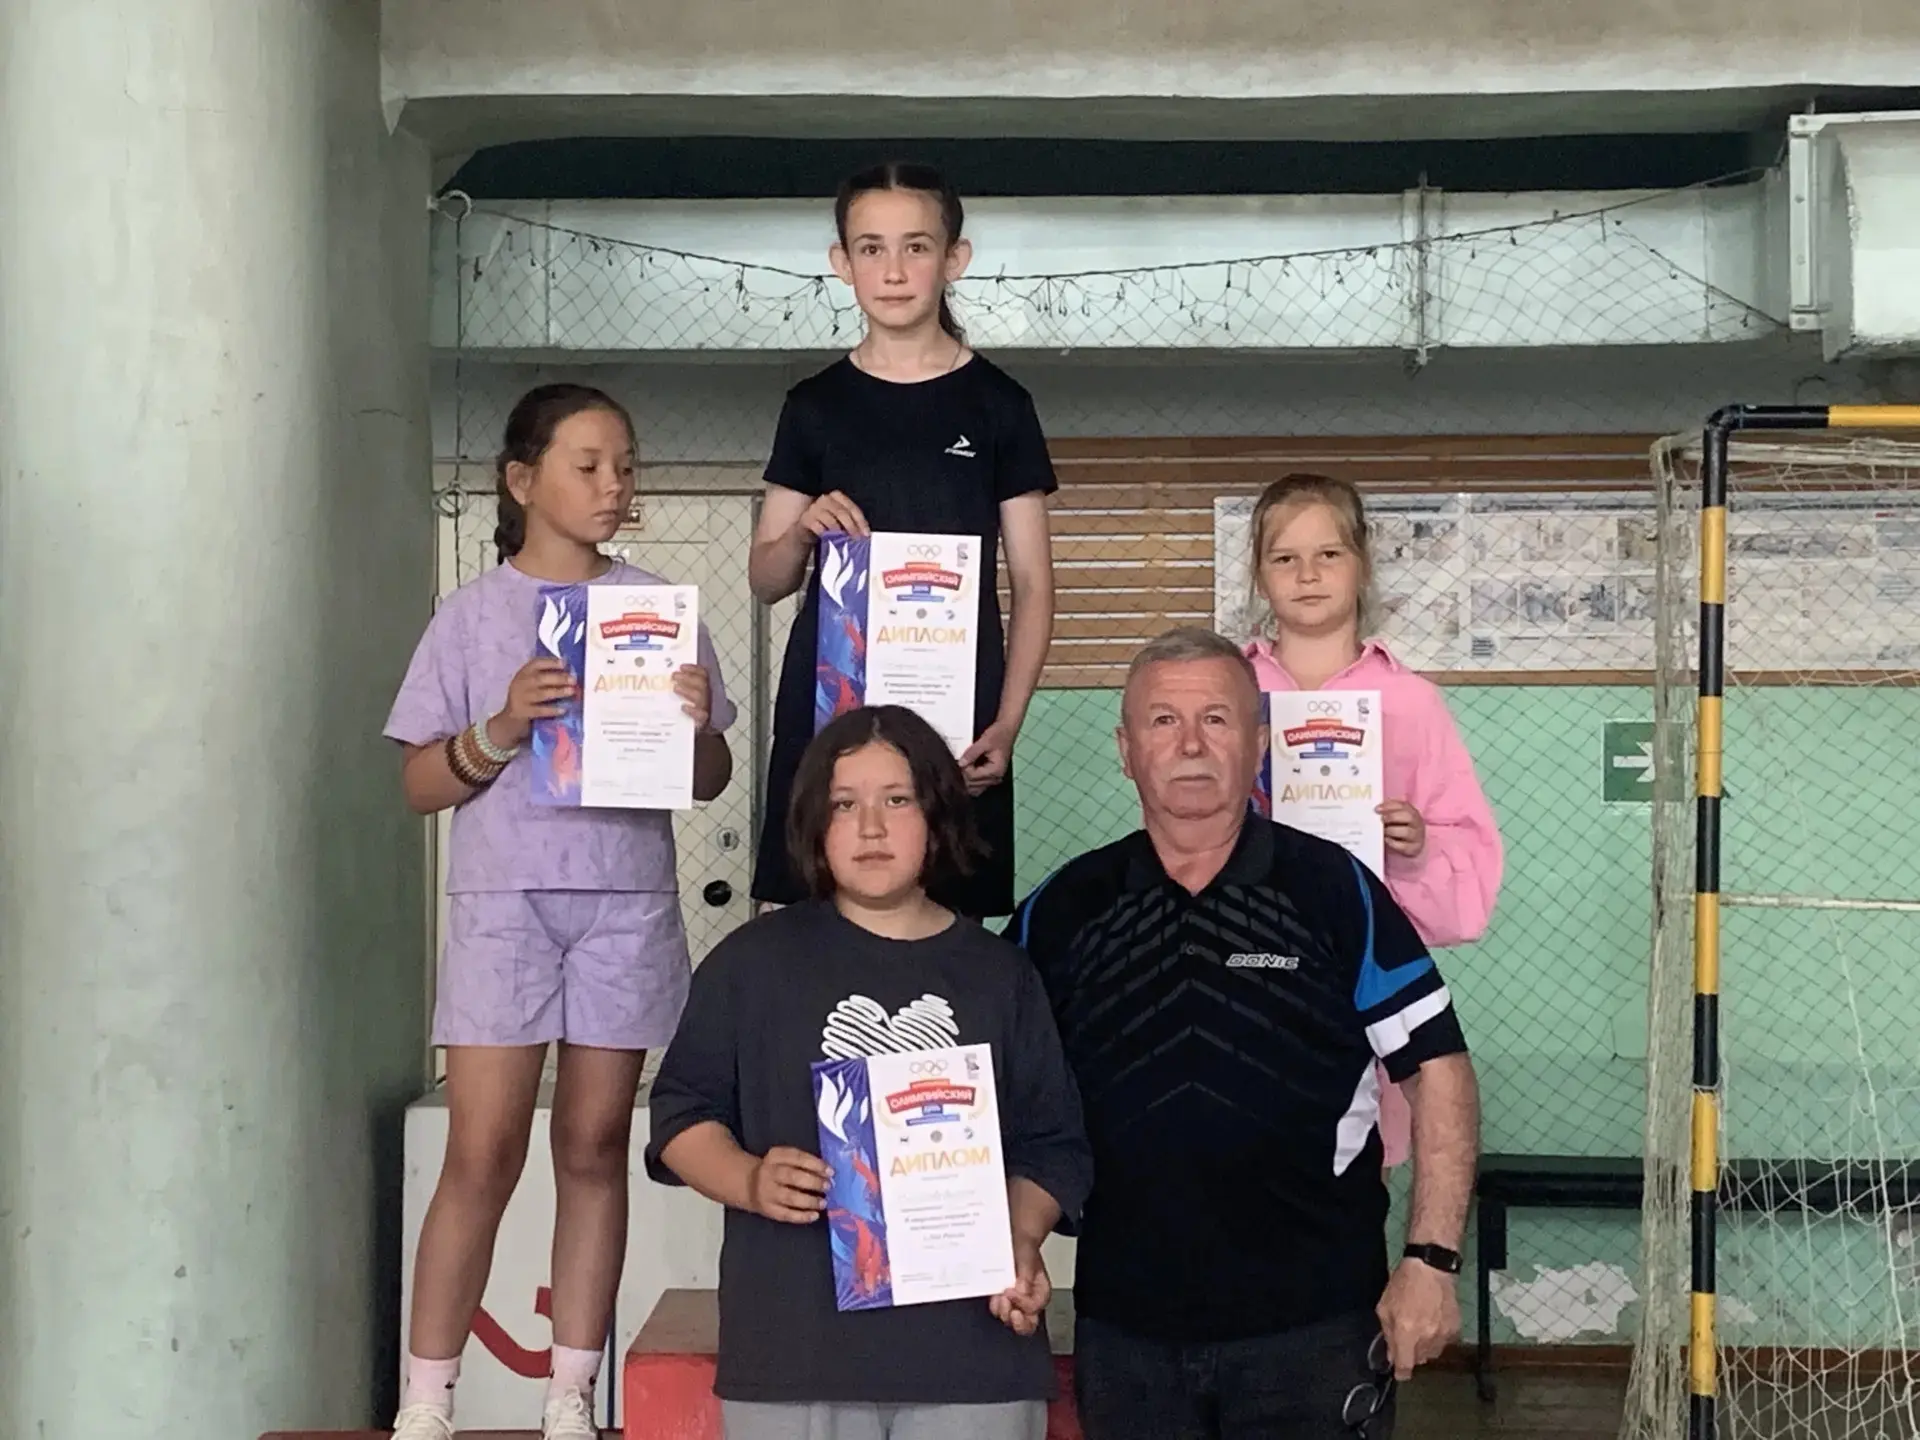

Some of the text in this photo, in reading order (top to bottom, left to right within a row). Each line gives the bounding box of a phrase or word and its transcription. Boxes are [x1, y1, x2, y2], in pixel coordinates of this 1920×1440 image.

[877, 625, 966, 645] ДИПЛОМ
[1281, 783, 1372, 804] ДИПЛОМ
[889, 1146, 991, 1178] ДИПЛОМ
